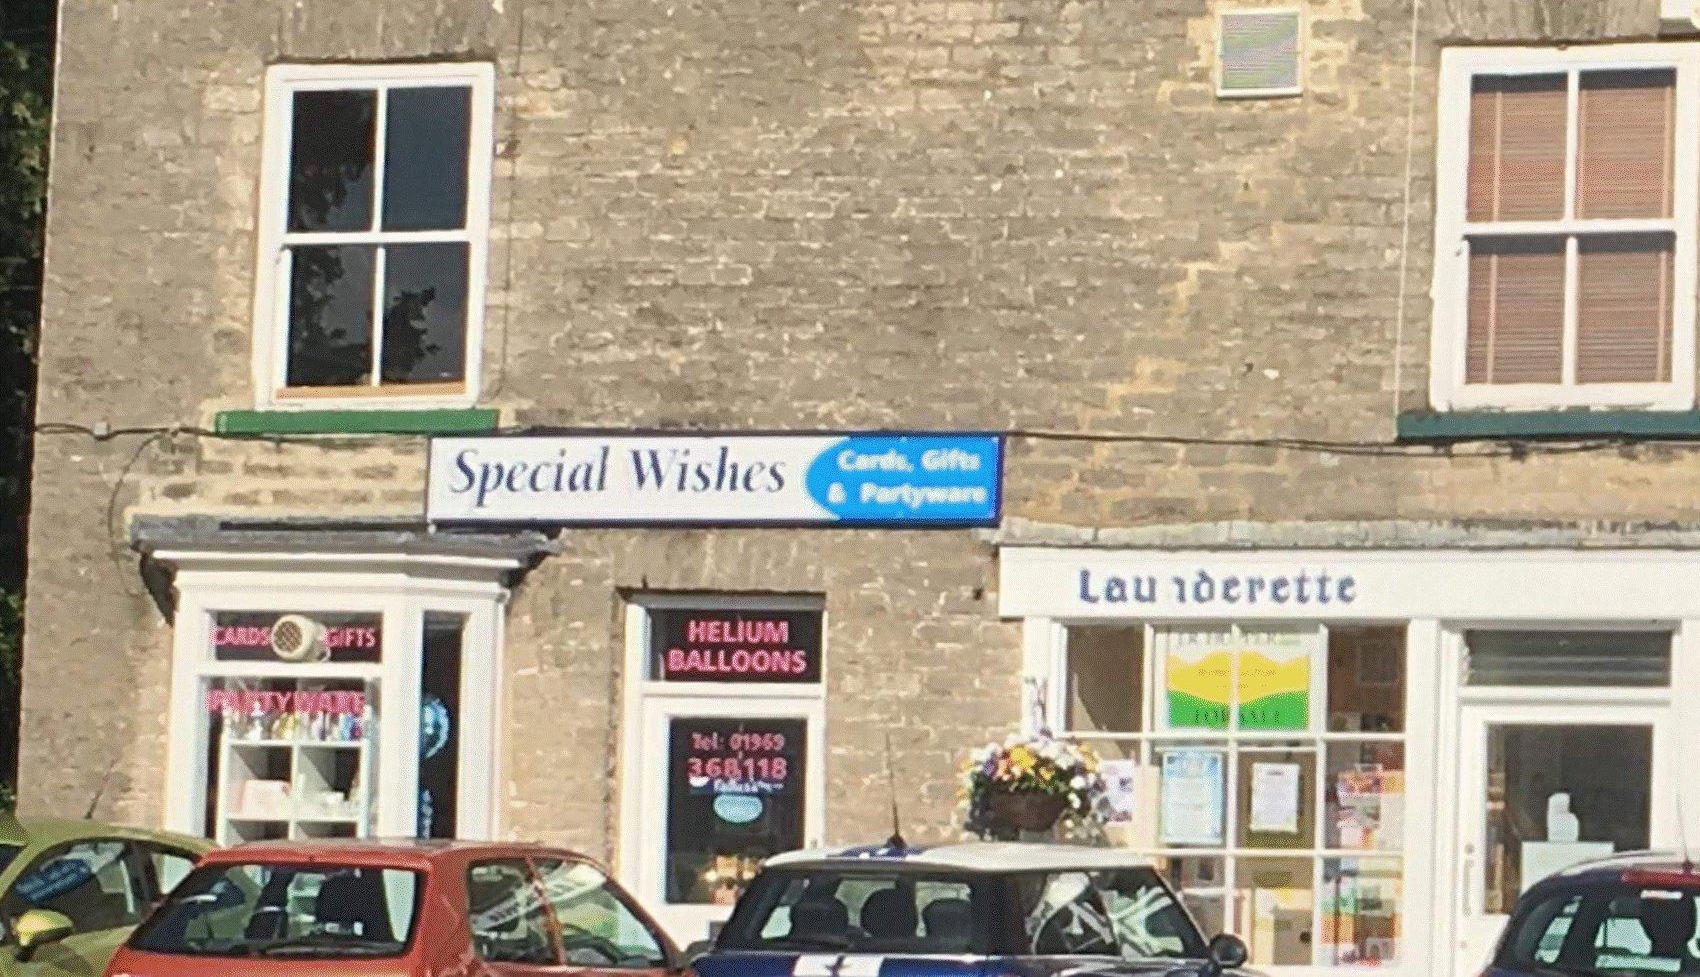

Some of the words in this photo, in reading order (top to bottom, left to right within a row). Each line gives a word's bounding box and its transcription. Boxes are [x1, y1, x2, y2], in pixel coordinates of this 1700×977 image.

[837, 448, 915, 473] Cards,
[921, 448, 982, 473] Gifts
[450, 445, 610, 509] Special
[629, 445, 787, 493] Wishes
[859, 481, 988, 510] Partyware
[210, 626, 272, 647] CARDS
[323, 626, 377, 648] GIFTS
[687, 619, 790, 644] HELIUM
[668, 648, 808, 675] BALLOONS
[690, 731, 724, 752] Tel:
